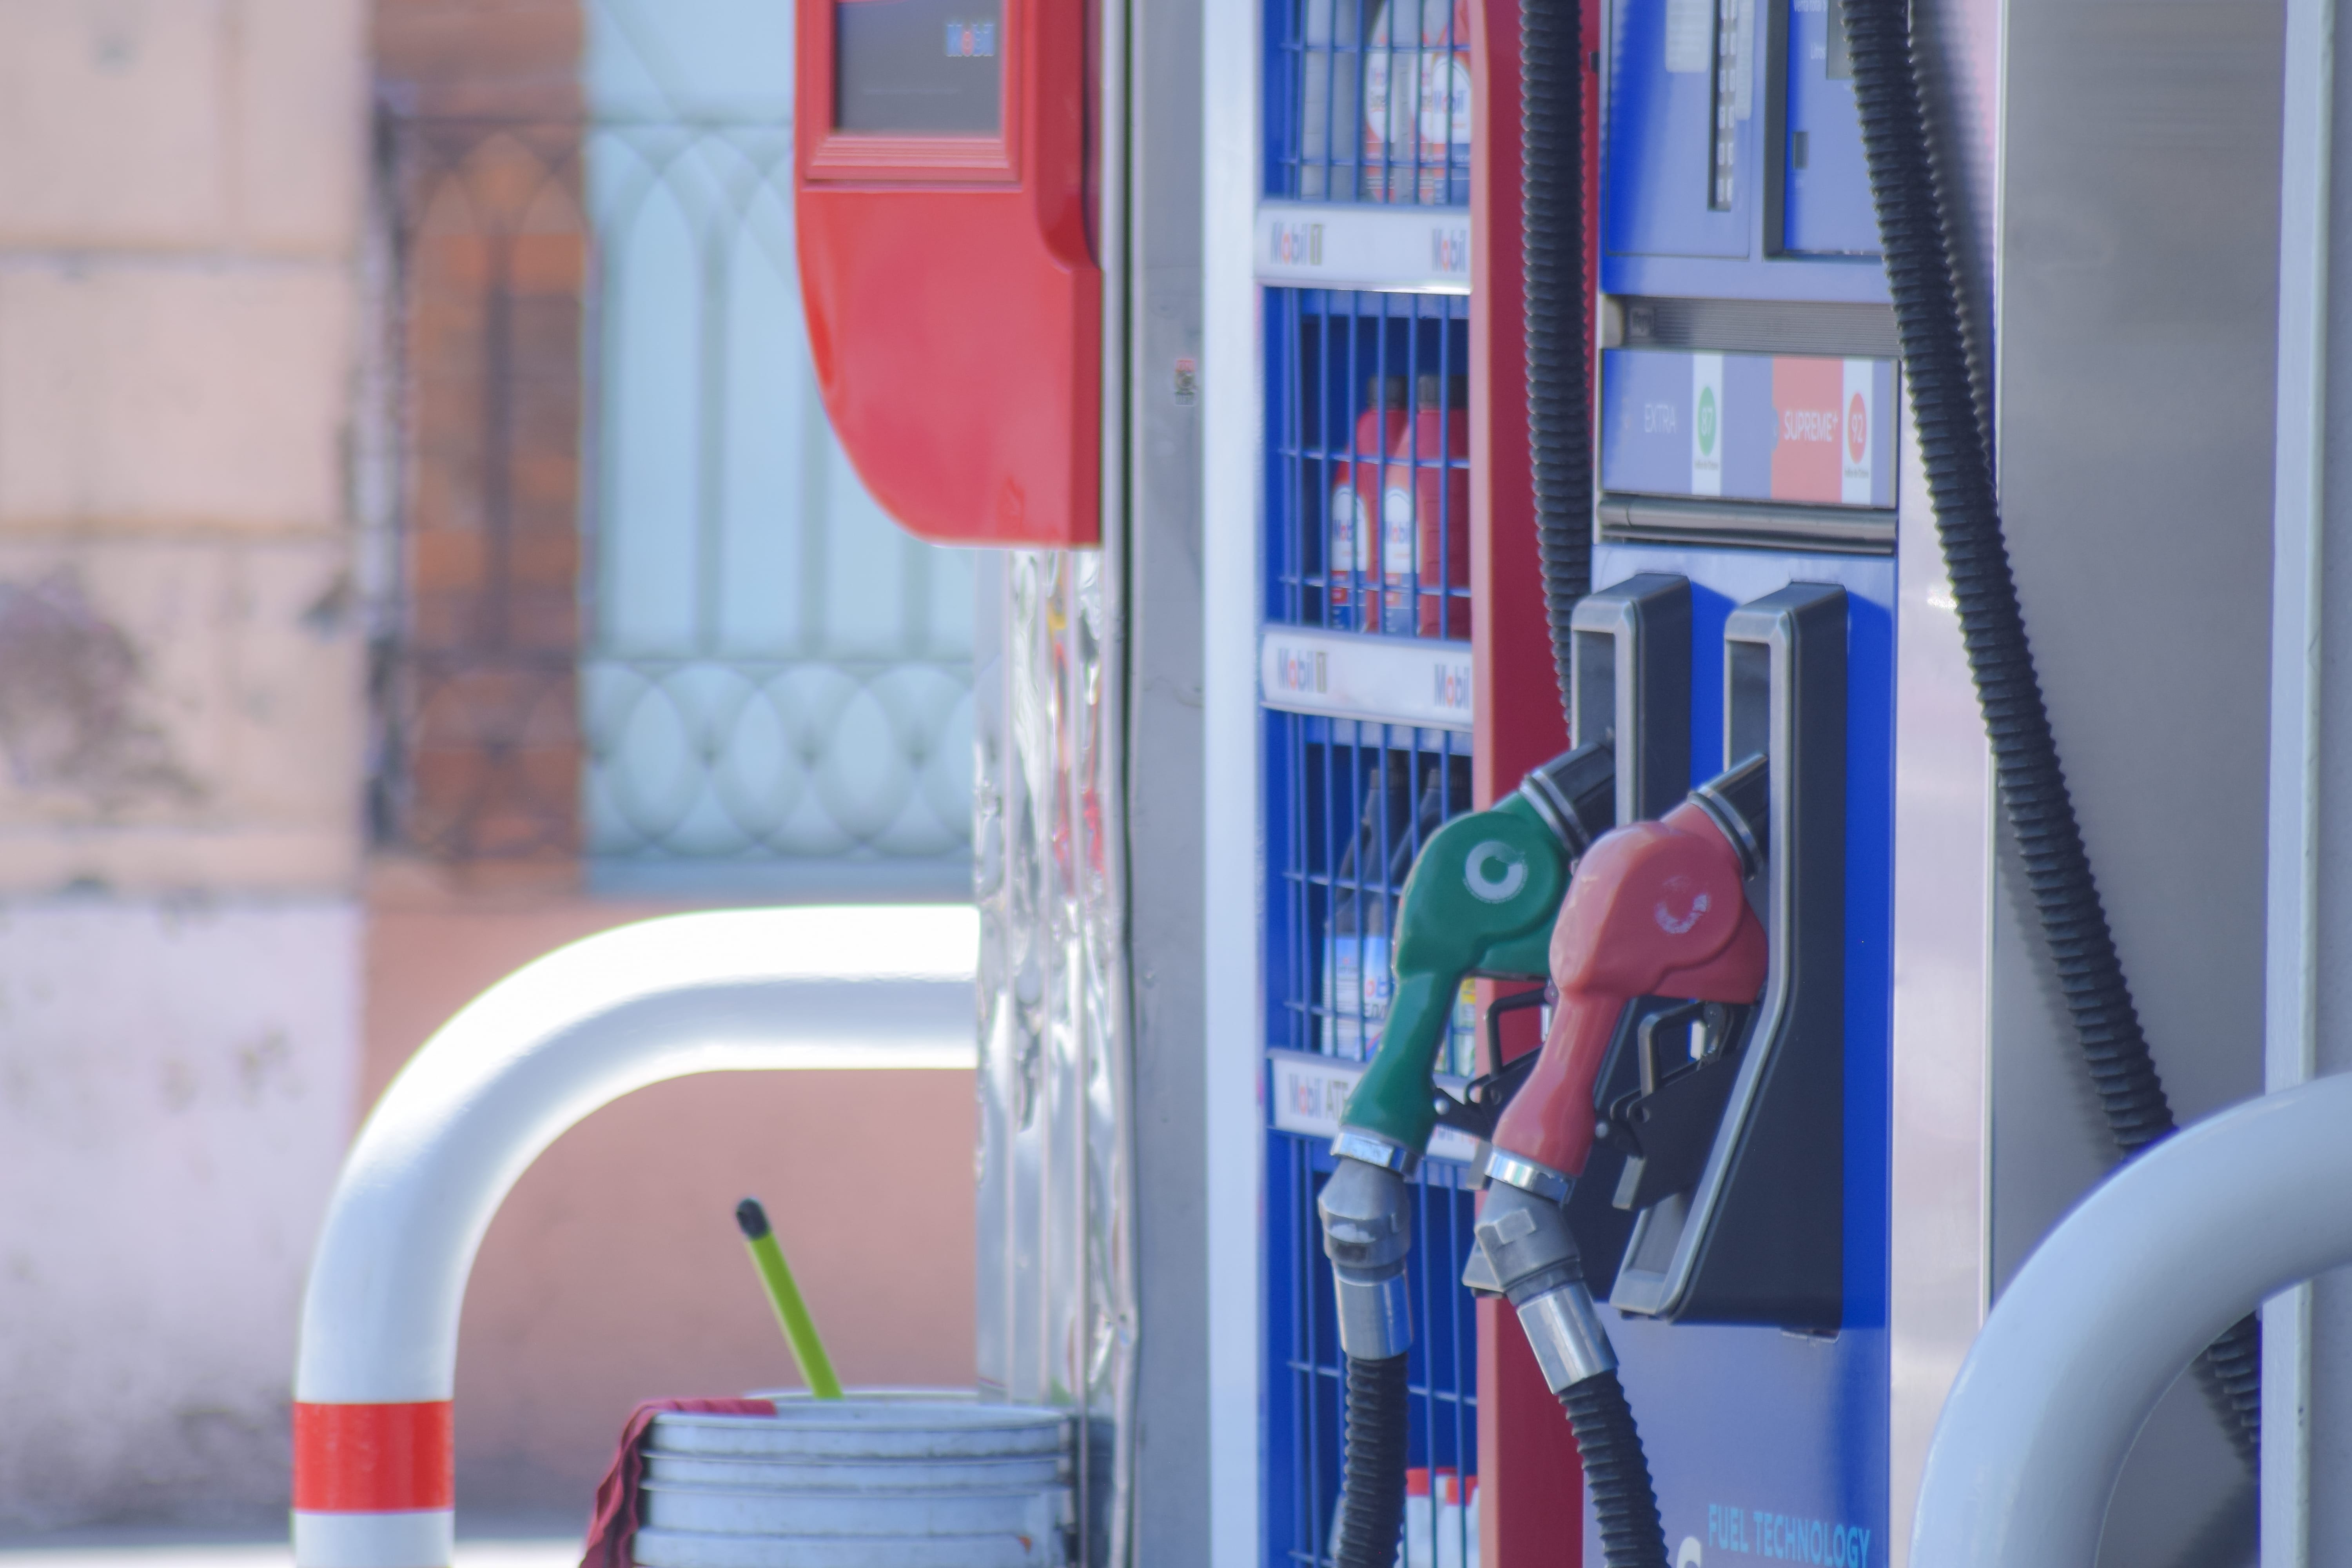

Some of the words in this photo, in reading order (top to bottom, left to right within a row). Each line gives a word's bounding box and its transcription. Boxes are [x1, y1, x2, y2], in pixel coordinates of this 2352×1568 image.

[1270, 222, 1307, 265] Mobil
[1432, 229, 1466, 272] Mobil
[1645, 404, 1676, 434] EXTRA
[1702, 408, 1713, 436] 87
[1784, 410, 1838, 442] SUPREME+
[1852, 414, 1862, 443] 92
[1332, 519, 1356, 542] Mob
[1278, 648, 1314, 692] Mobil
[1434, 664, 1470, 709] Mobil
[1289, 1073, 1322, 1119] Mobil
[1709, 1503, 1749, 1553] FUEL
[1753, 1511, 1871, 1568] TECHNOLOGY
